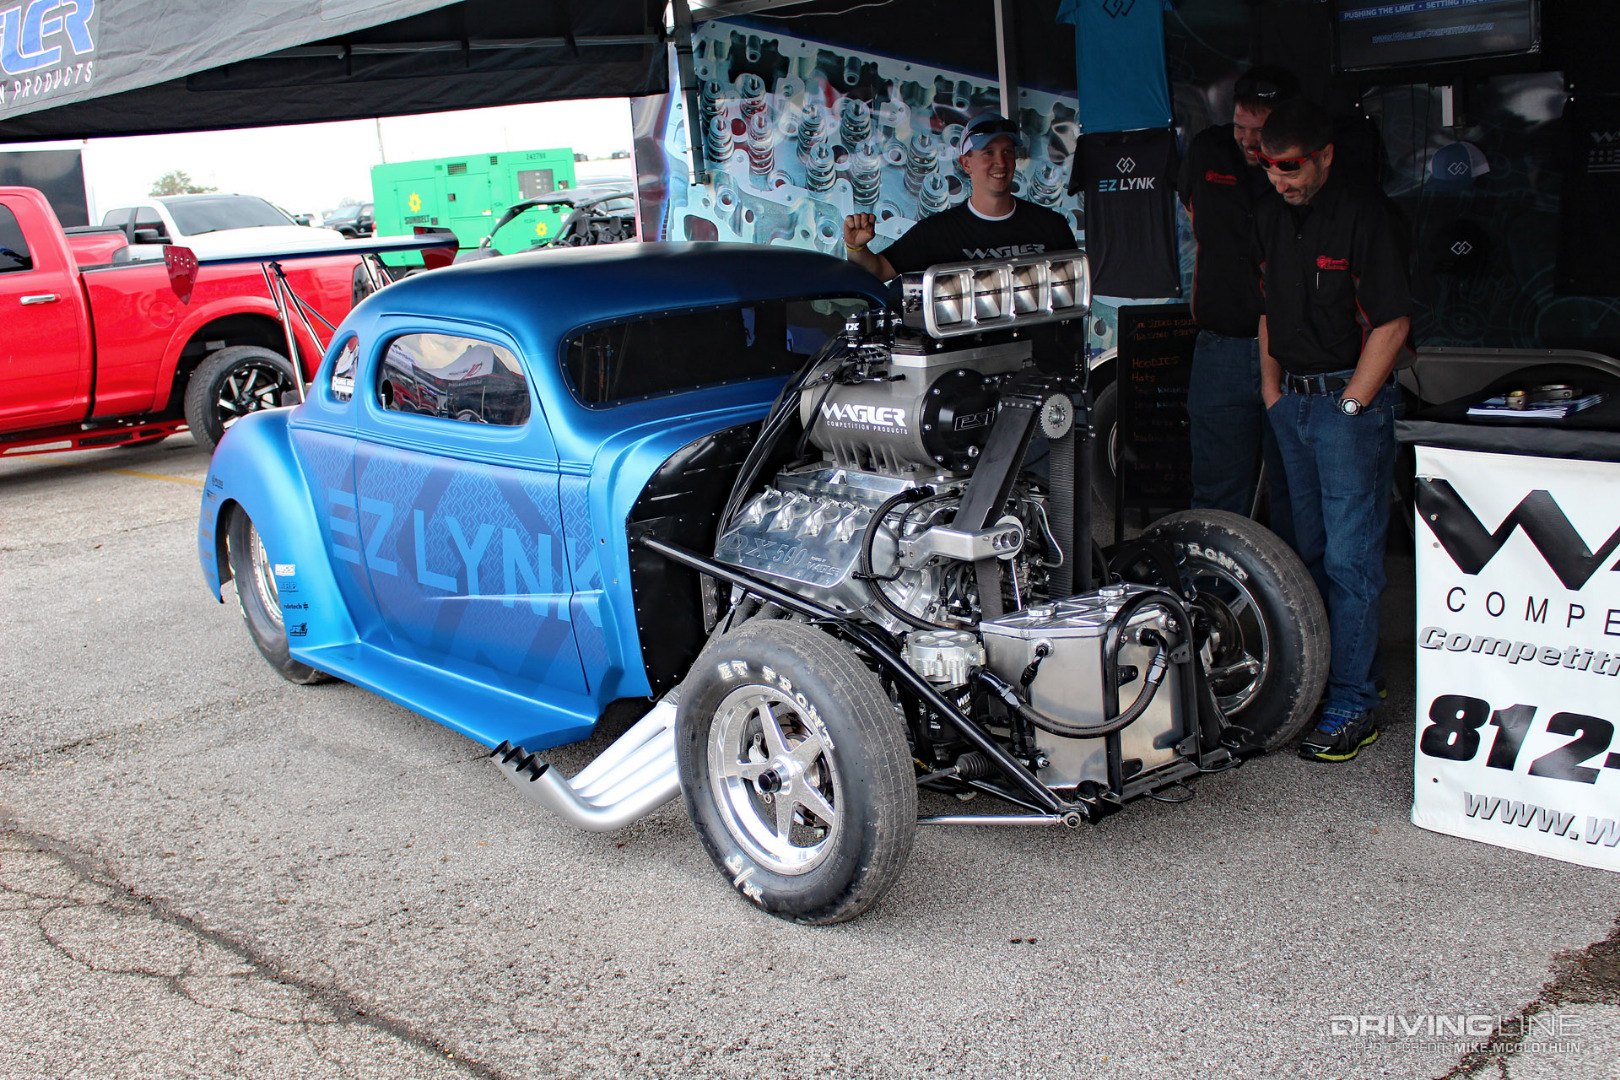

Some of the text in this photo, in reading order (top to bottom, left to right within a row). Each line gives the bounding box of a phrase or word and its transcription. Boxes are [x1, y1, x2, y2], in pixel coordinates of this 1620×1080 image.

[1344, 9, 1377, 20] PUSHING
[1378, 7, 1393, 16] THE
[1395, 3, 1416, 13] LIMIT
[1426, 0, 1459, 9] SETTING
[0, 0, 95, 75] LER
[13, 60, 94, 100] PRODUCTS
[1098, 177, 1156, 192] EZ LYNK
[962, 243, 1046, 260] WAGLER
[821, 401, 907, 427] WAGLER
[826, 420, 908, 435] COMPETITION PRODUCTS
[328, 487, 398, 577] EZ
[414, 508, 603, 628] LYNK
[718, 660, 750, 682] ET
[762, 665, 835, 751] FRONT
